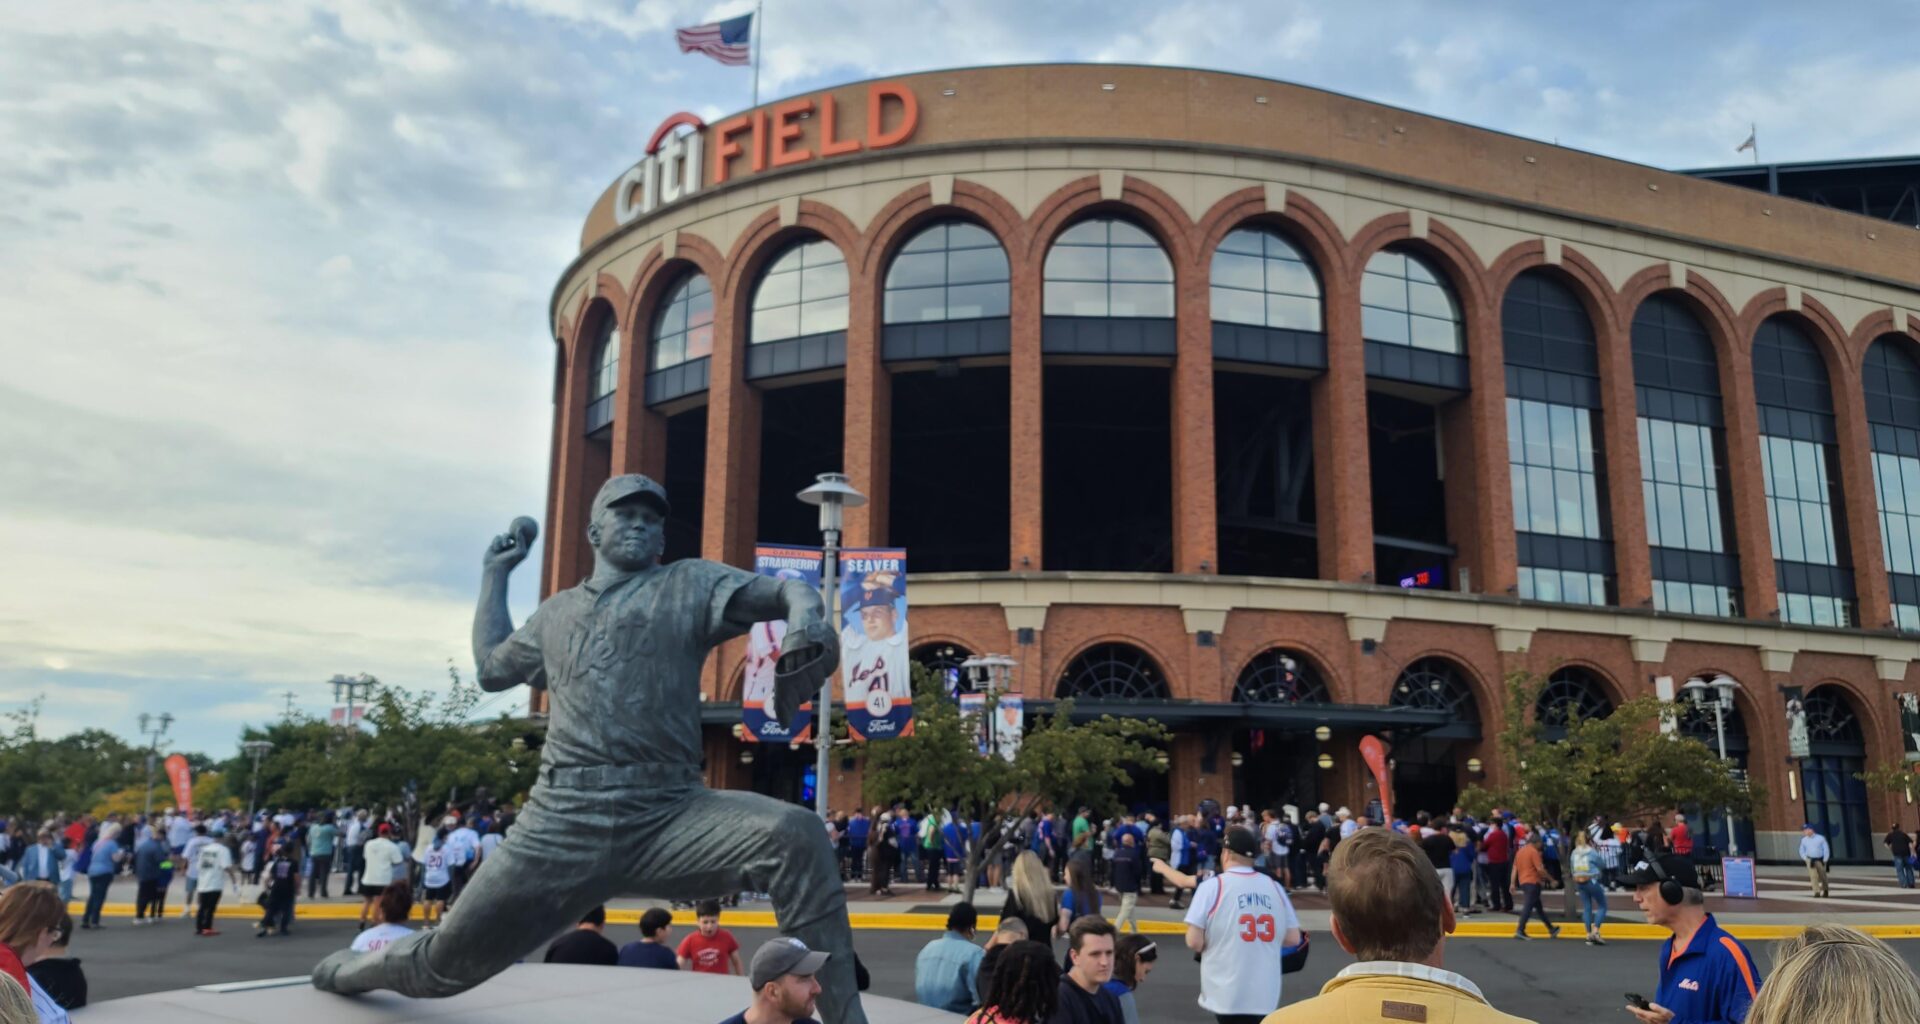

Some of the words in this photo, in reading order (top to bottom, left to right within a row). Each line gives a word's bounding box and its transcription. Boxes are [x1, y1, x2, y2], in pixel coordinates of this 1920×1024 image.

[614, 124, 704, 226] citi
[714, 82, 919, 184] FIELD
[758, 556, 820, 571] STRAWBERRY
[847, 559, 900, 573] SEAVER
[873, 698, 885, 709] 41
[867, 719, 895, 733] Ford
[1237, 894, 1271, 910] EWING
[1239, 914, 1275, 942] 33
[1679, 978, 1699, 991] Mets
